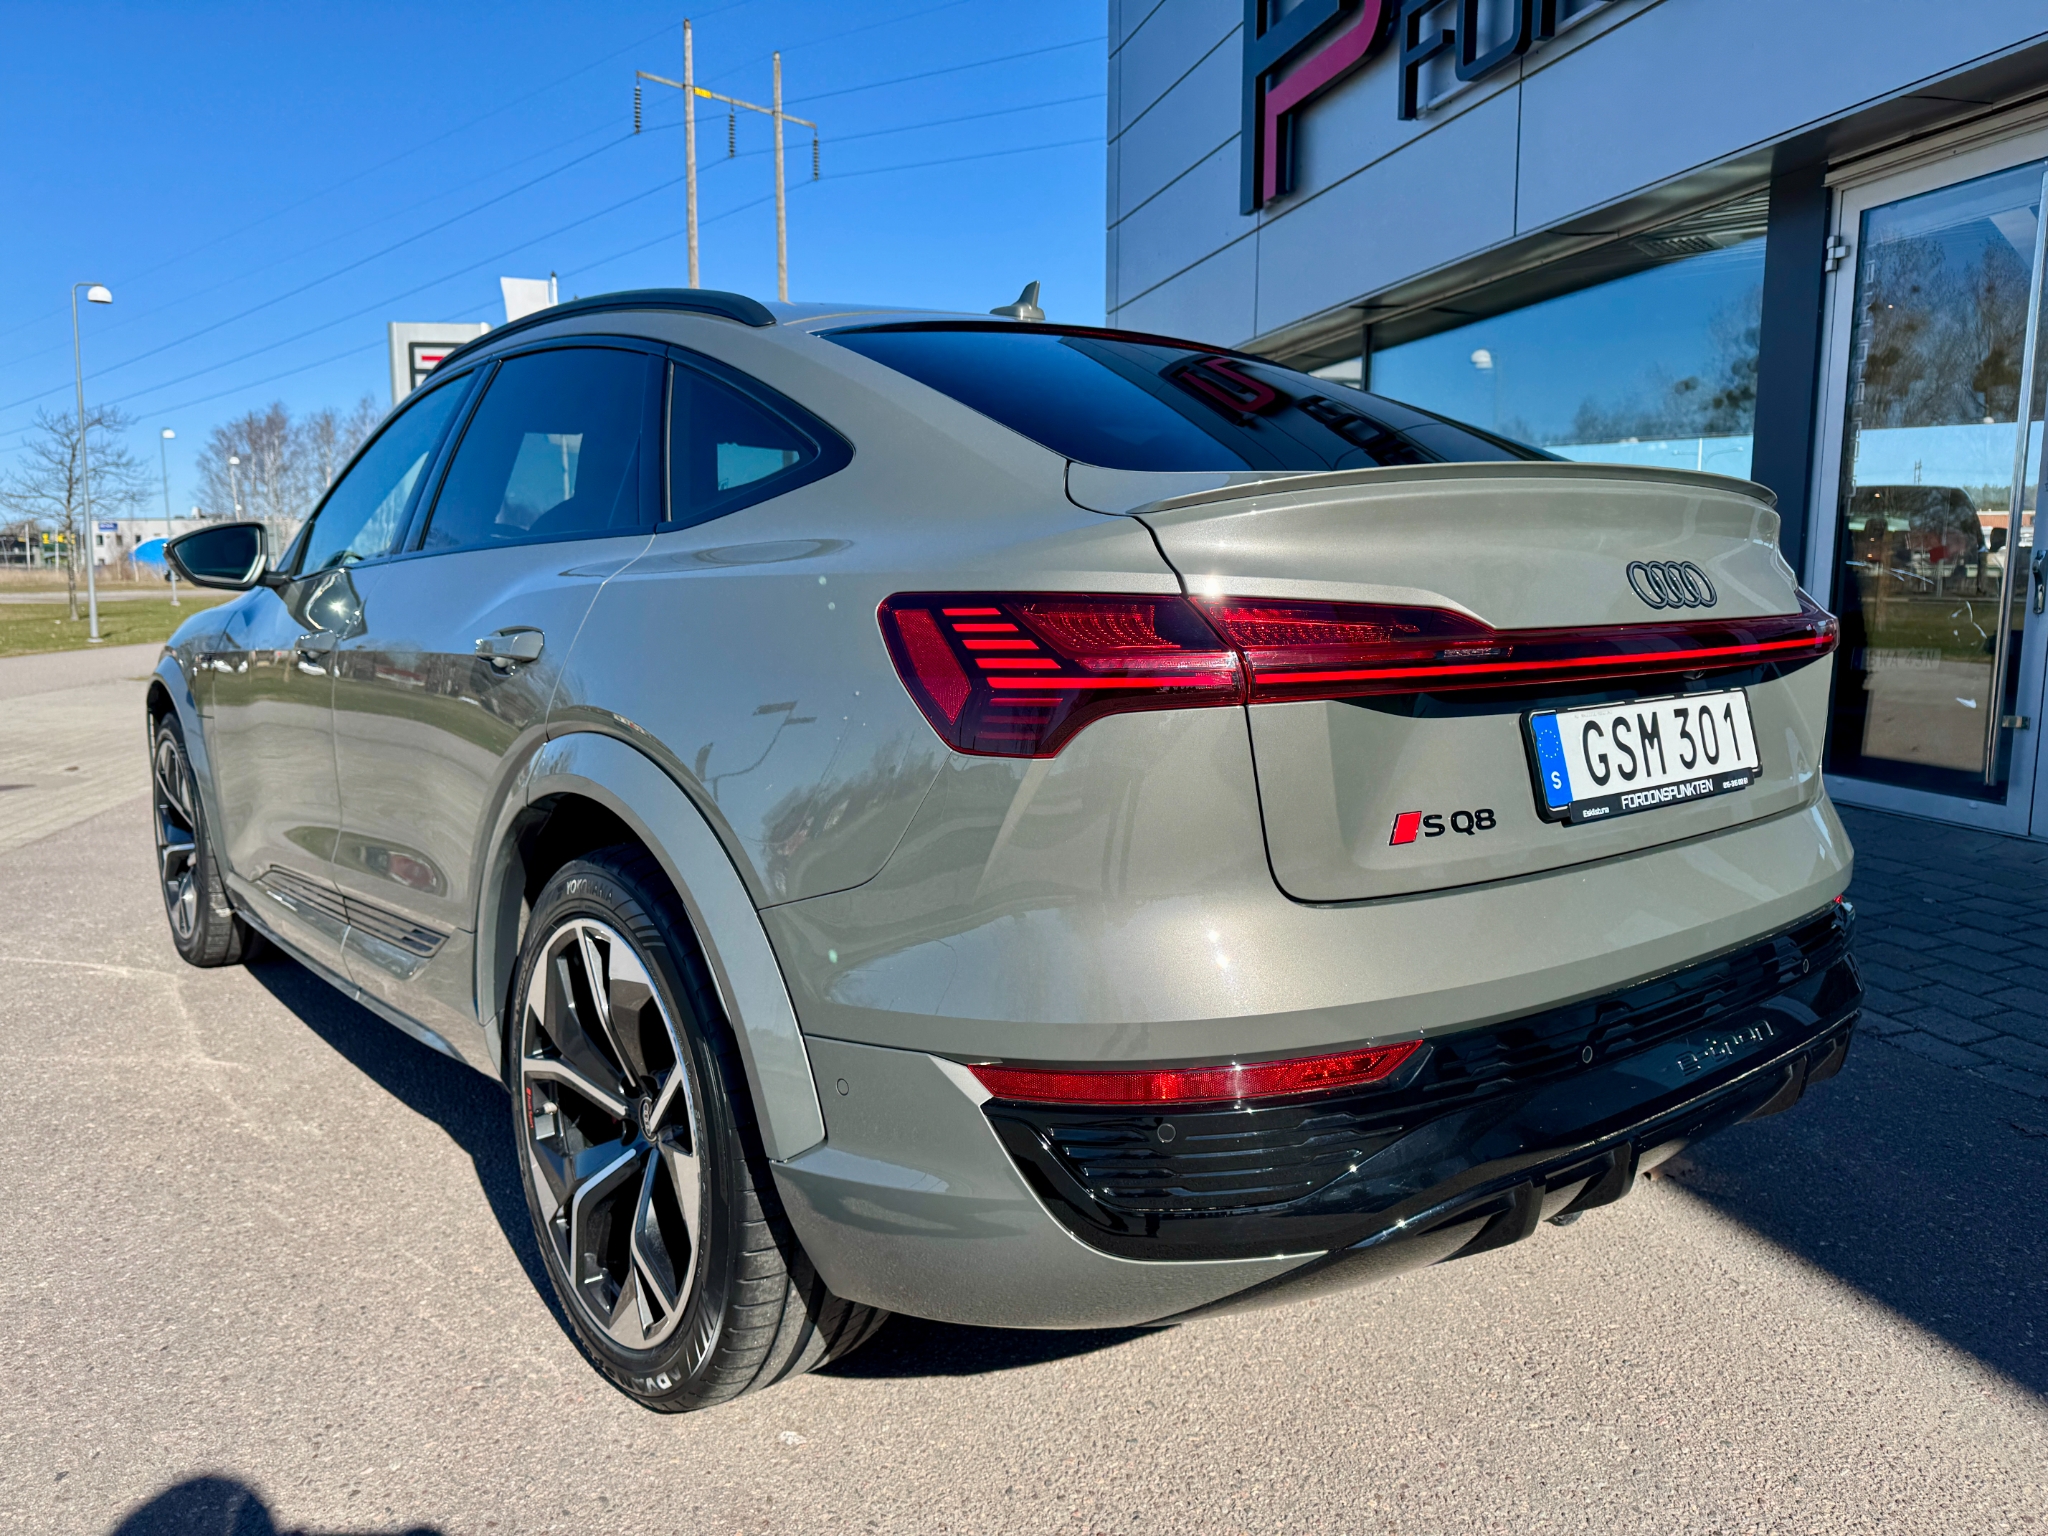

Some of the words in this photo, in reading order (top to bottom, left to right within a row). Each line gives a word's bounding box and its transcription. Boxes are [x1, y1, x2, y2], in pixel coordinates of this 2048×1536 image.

[1582, 711, 1668, 787] GSM
[1673, 702, 1742, 770] 301
[1551, 771, 1562, 790] S
[1621, 778, 1714, 810] FORDONSPUNKTEN
